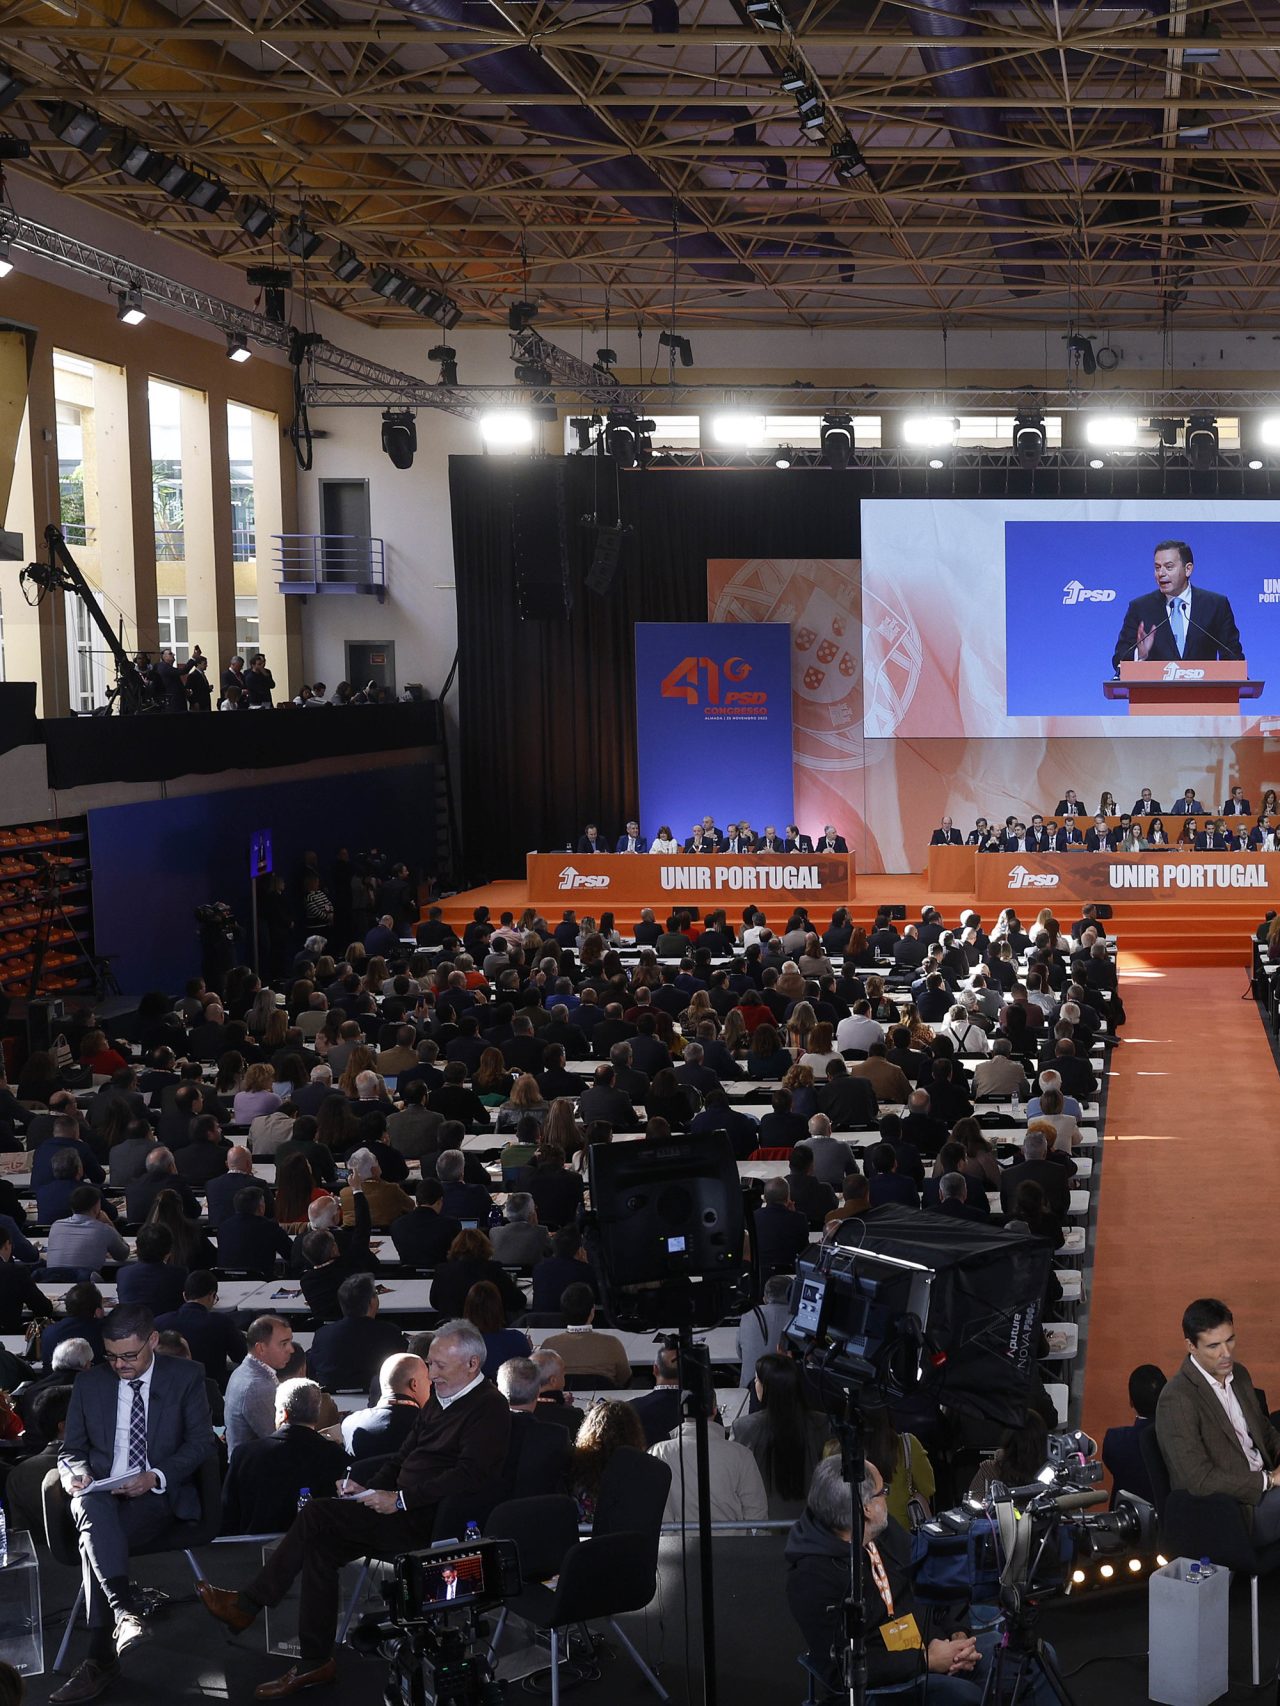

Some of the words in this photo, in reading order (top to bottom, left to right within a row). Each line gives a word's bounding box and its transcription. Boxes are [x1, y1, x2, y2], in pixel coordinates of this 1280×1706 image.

[1078, 590, 1117, 602] PSD
[1175, 668, 1205, 679] PSD
[725, 691, 768, 705] PSD
[704, 707, 768, 715] CONGRESSO
[573, 875, 611, 887] PSD
[660, 866, 711, 890] UNIR
[715, 866, 822, 890] PORTUGAL
[1022, 874, 1060, 886] PSD
[1109, 864, 1159, 888] UNIR
[1163, 864, 1268, 888] PORTUGAL
[1006, 1313, 1022, 1358] Aputure
[1017, 1332, 1032, 1369] NOVA
